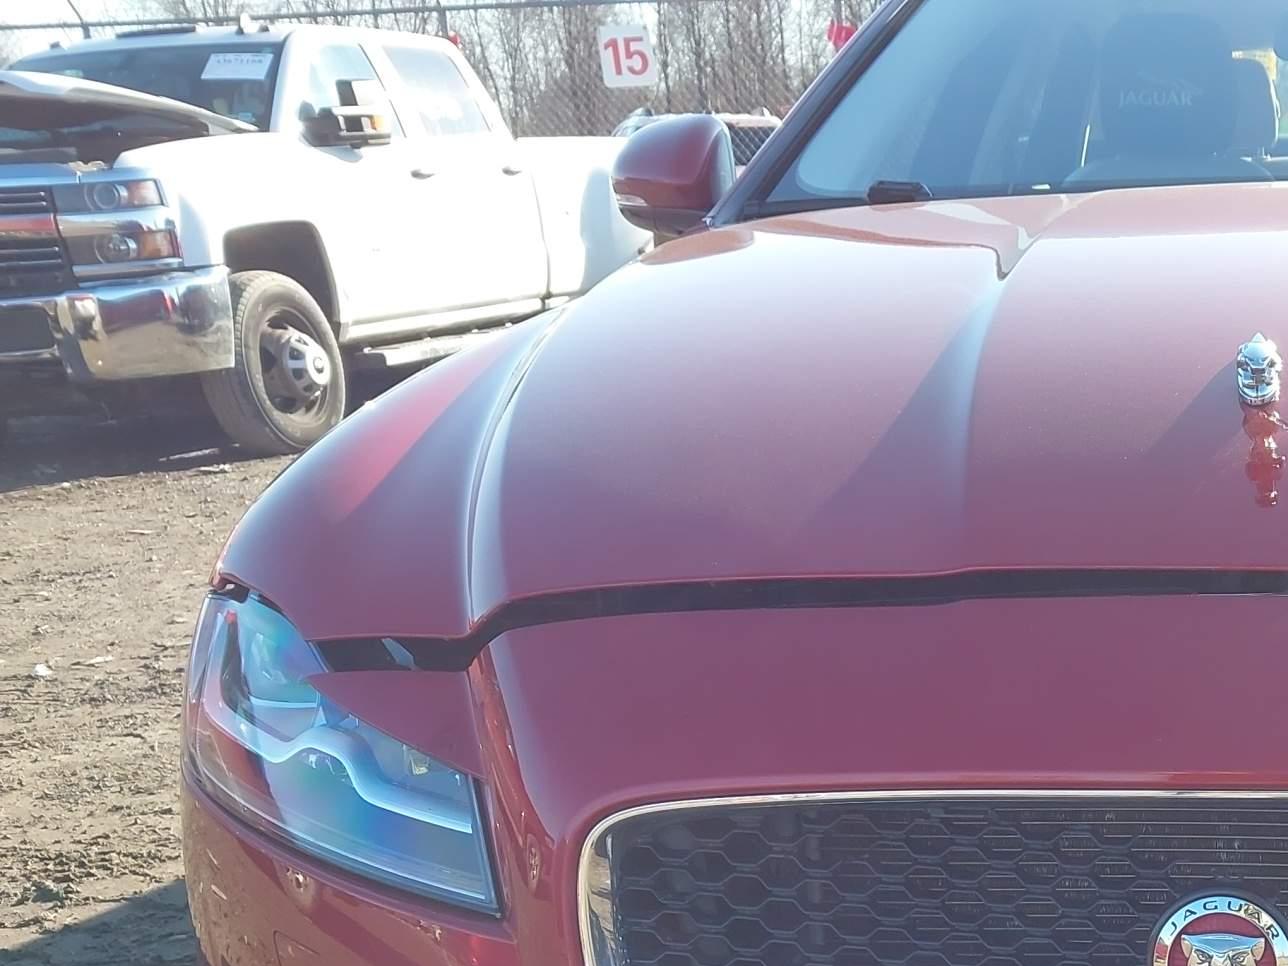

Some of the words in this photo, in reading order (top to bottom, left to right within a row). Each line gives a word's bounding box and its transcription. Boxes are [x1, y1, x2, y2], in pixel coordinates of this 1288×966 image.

[604, 36, 649, 76] 15
[1118, 90, 1193, 107] JAGUAR
[1170, 900, 1280, 940] JAGUAR
